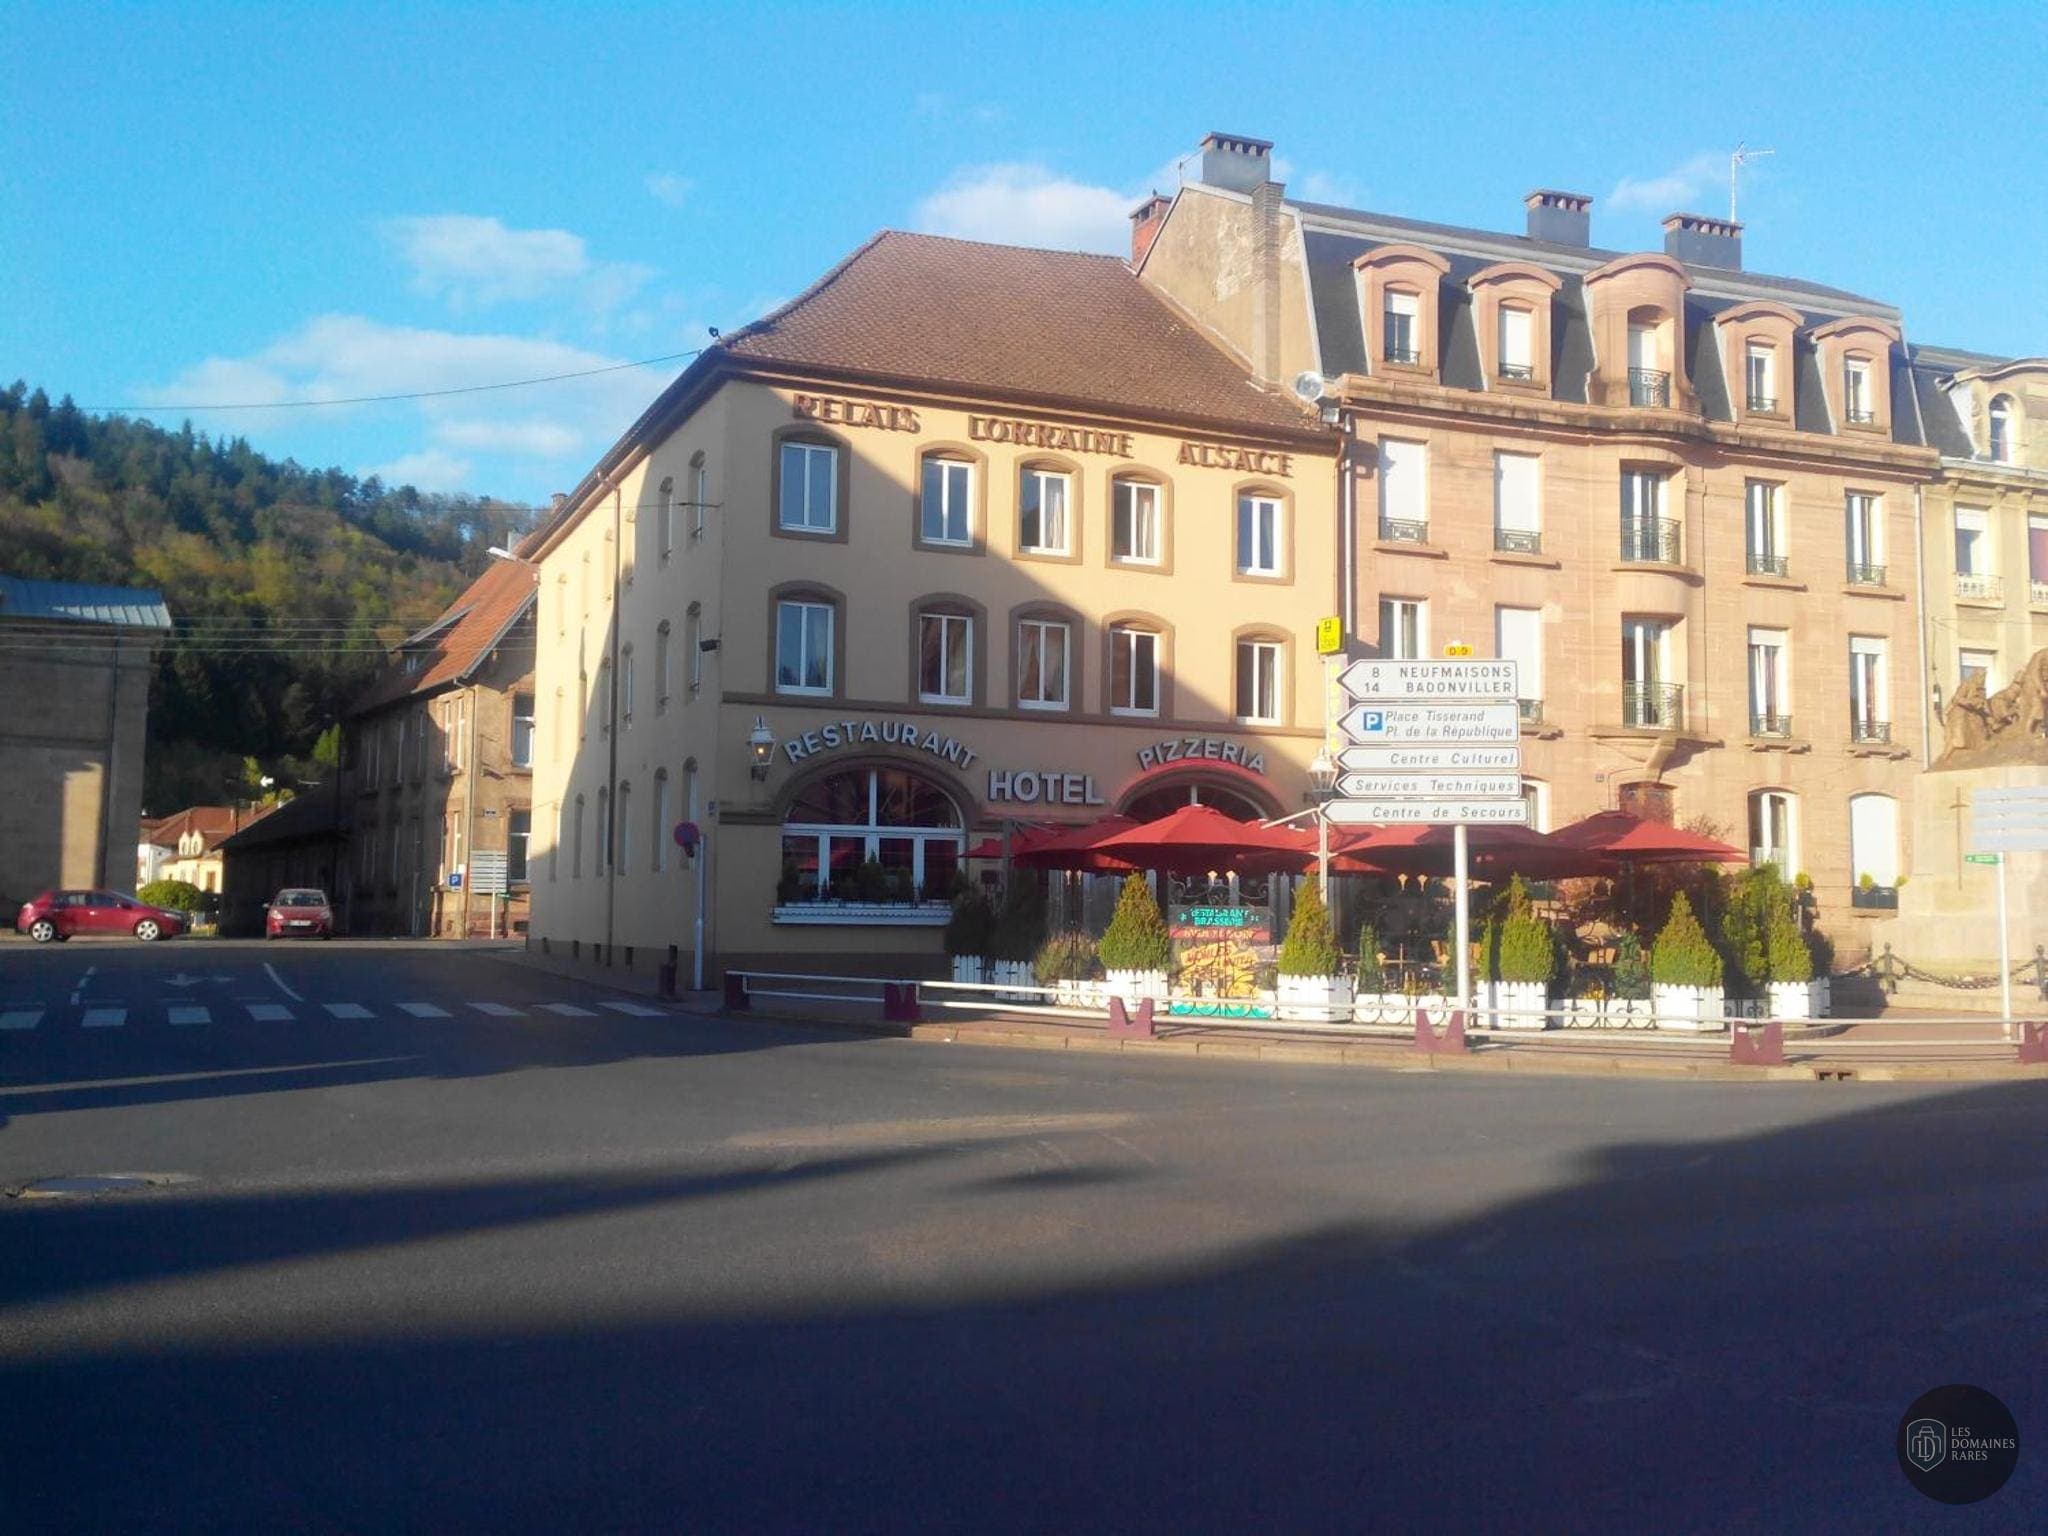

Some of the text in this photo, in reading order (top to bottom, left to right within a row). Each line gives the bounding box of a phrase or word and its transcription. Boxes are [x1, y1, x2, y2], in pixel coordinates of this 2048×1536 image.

[794, 393, 1294, 477] RELAIS LORRAINE ALSACE
[1372, 667, 1512, 678] 8 NEUFMAISONS
[1364, 682, 1512, 693] 14 BADONVILLER
[1385, 710, 1485, 722] Place Tisserand
[1406, 726, 1421, 737] de
[1426, 726, 1437, 737] la
[784, 719, 977, 771] RESTAURANT
[1137, 737, 1266, 775] PIZZERIA
[1390, 752, 1514, 765] Centre Culturel
[988, 770, 1104, 805] HOTEL
[1355, 780, 1514, 793] Services Techniques
[1372, 806, 1521, 818] Centre de Secours
